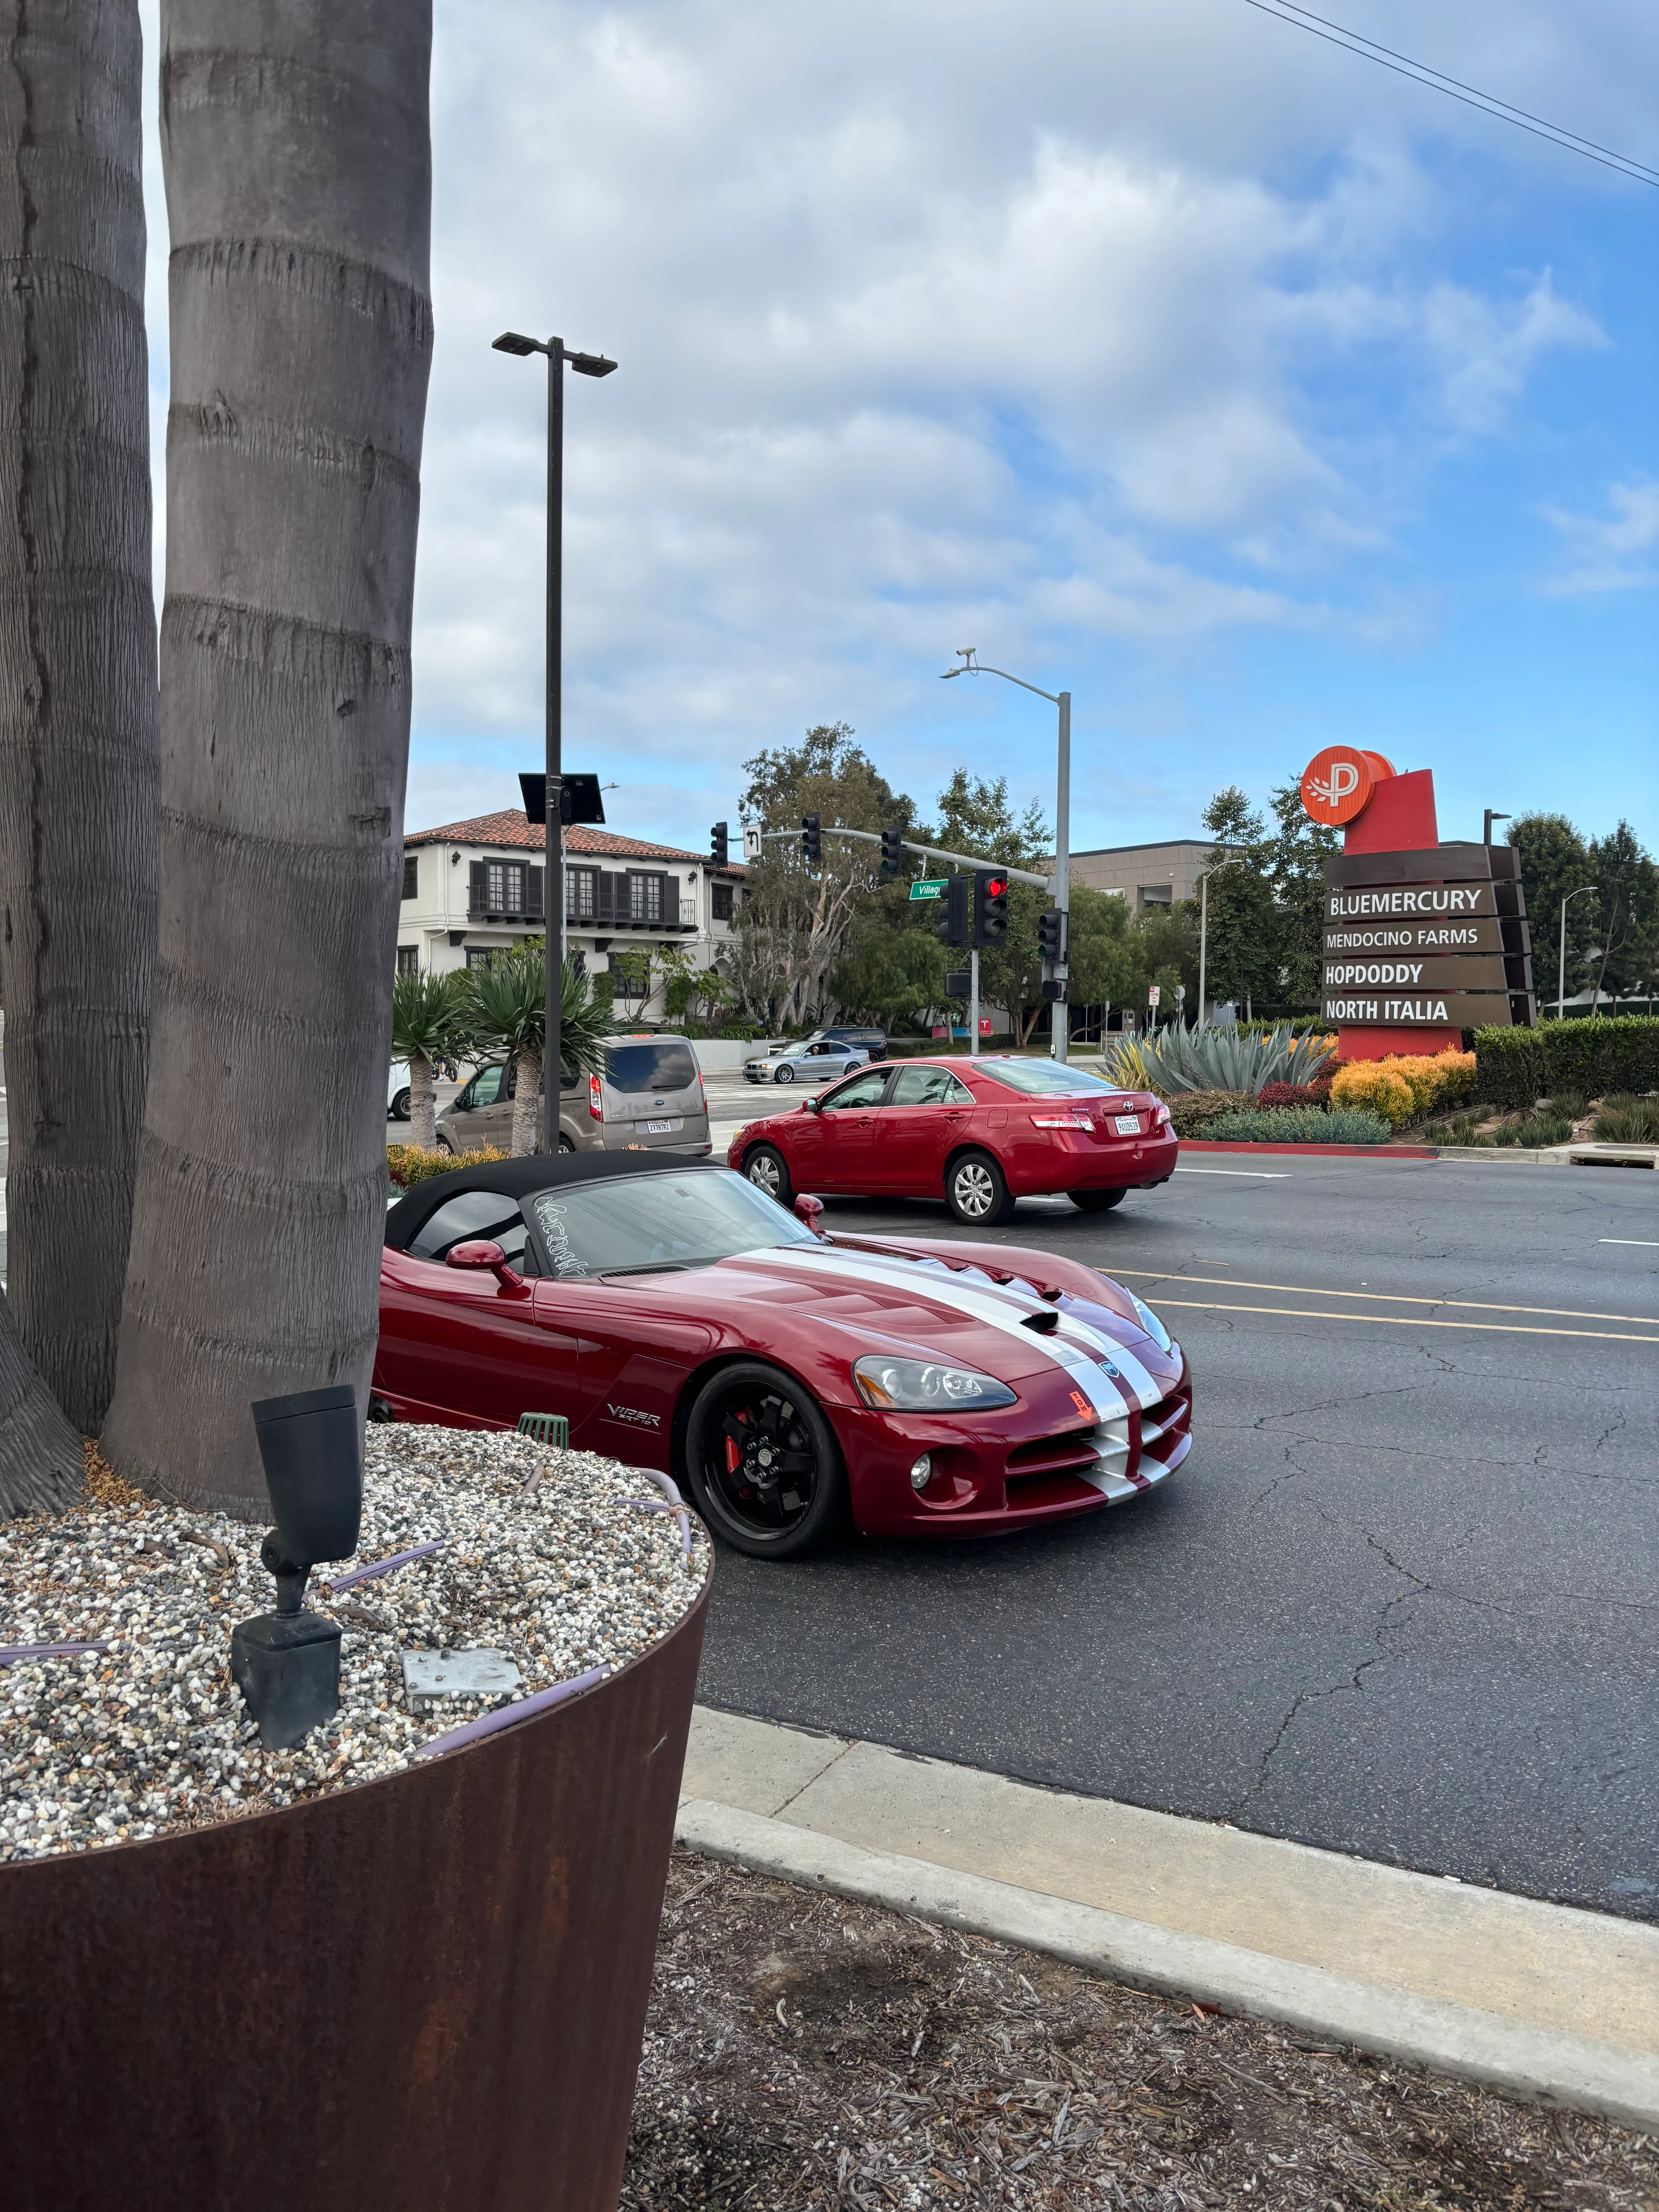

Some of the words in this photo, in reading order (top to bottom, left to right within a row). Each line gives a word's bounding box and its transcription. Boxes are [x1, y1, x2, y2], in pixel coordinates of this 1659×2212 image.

[1331, 889, 1482, 915] BLUEMERCURY
[1327, 931, 1412, 948] MENDOCINO
[1418, 928, 1478, 945] FARMS
[1326, 964, 1423, 984] HOPDODDY
[1327, 1001, 1377, 1019] NORTH
[1385, 1001, 1448, 1020] ITALIA
[1073, 1393, 1087, 1412] TOW
[607, 1404, 661, 1426] VIPER
